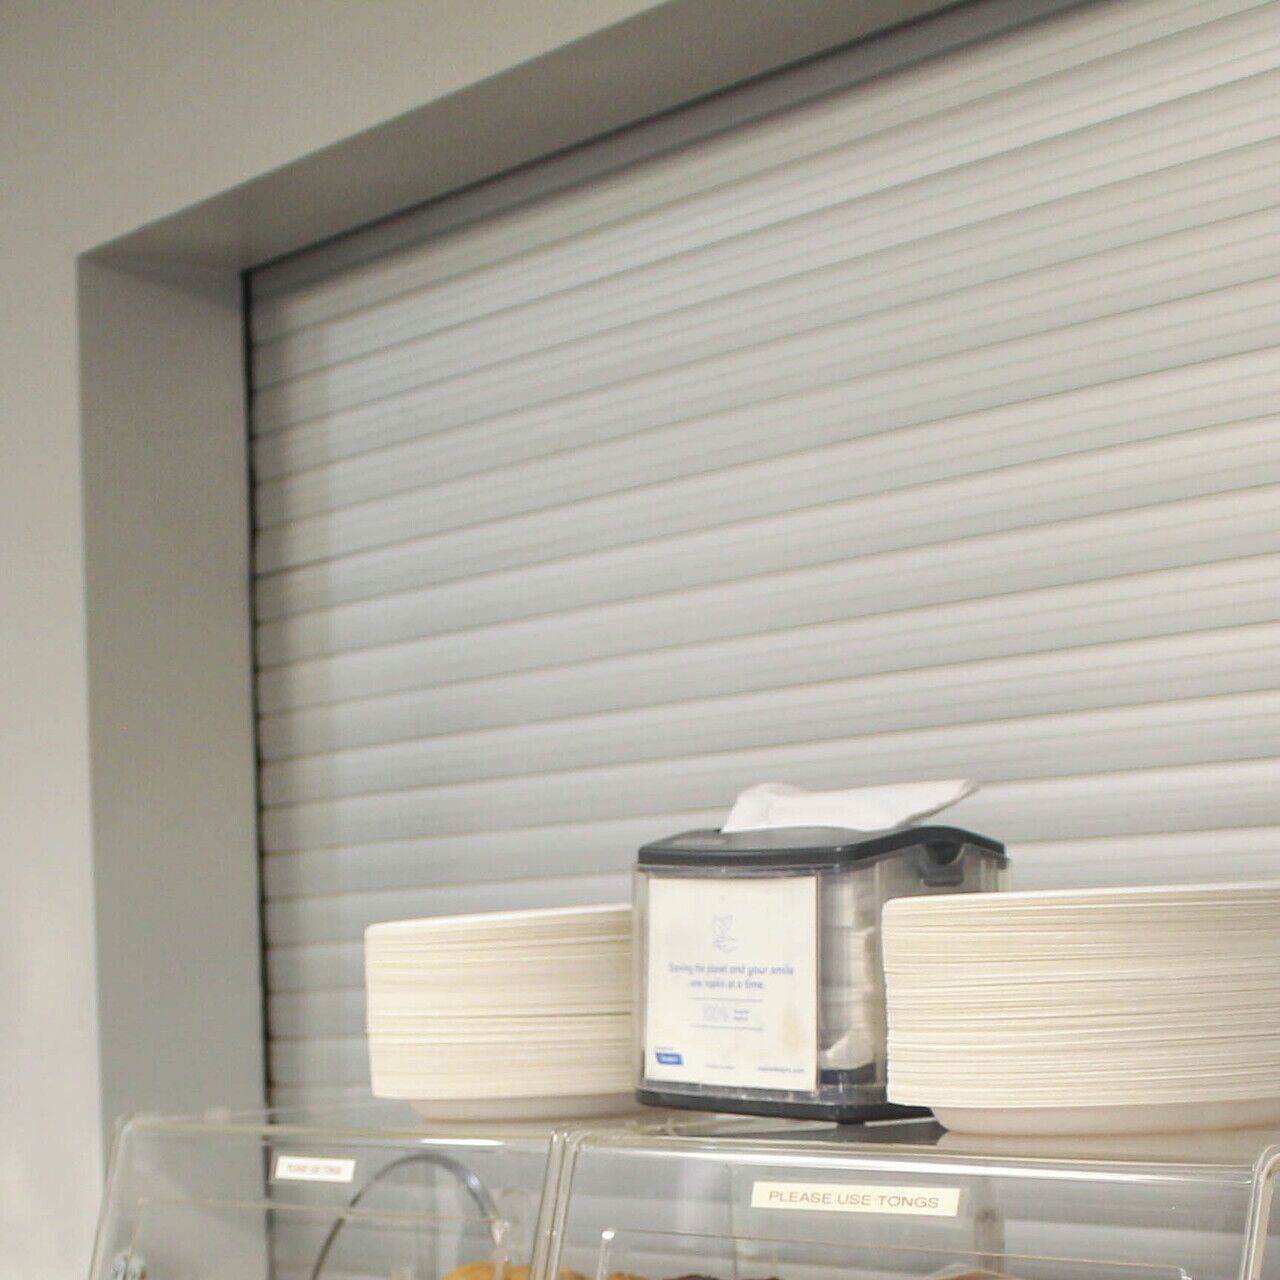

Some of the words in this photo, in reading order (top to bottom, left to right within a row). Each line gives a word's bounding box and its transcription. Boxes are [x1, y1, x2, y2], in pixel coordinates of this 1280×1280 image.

[769, 1190, 832, 1205] PLEASE
[837, 1193, 873, 1206] USE
[879, 1195, 939, 1209] TONGS
